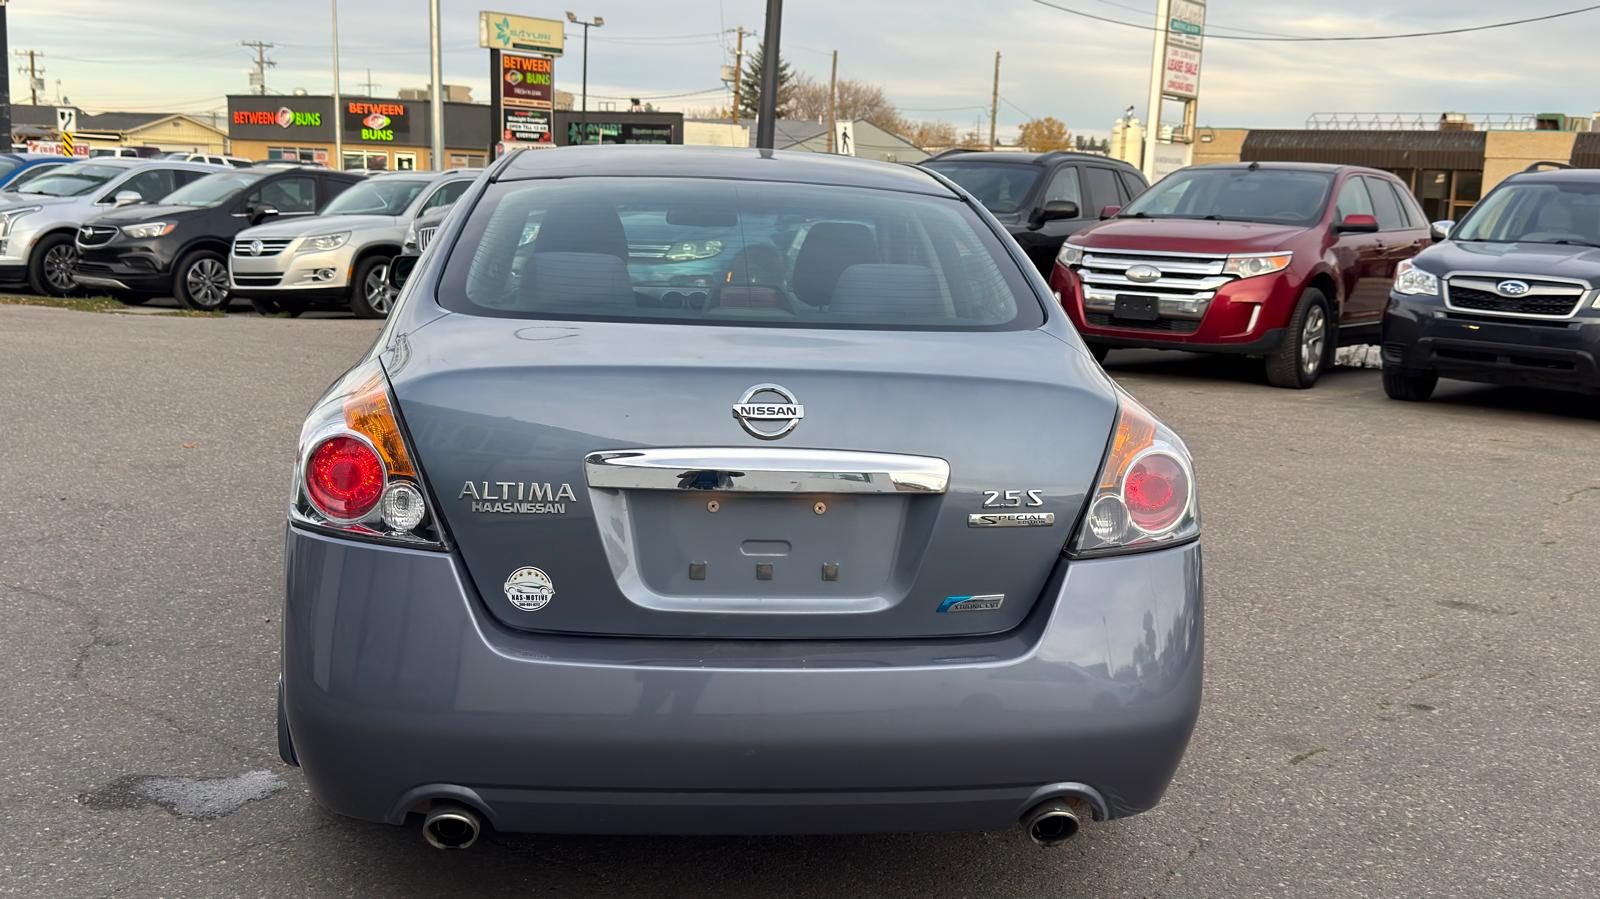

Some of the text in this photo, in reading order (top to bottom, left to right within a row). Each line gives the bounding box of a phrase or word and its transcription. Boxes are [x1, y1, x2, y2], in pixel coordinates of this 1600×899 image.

[503, 55, 551, 73] BETWEEN
[526, 72, 551, 86] BUNS
[349, 102, 404, 116] BETWEEN
[233, 111, 321, 127] BETWEEN BUNS
[361, 128, 394, 141] BUNS
[740, 406, 797, 416] NISSAN
[457, 480, 577, 502] ALTIMA
[1026, 489, 1044, 507] S
[980, 515, 1042, 525] SPECIAL
